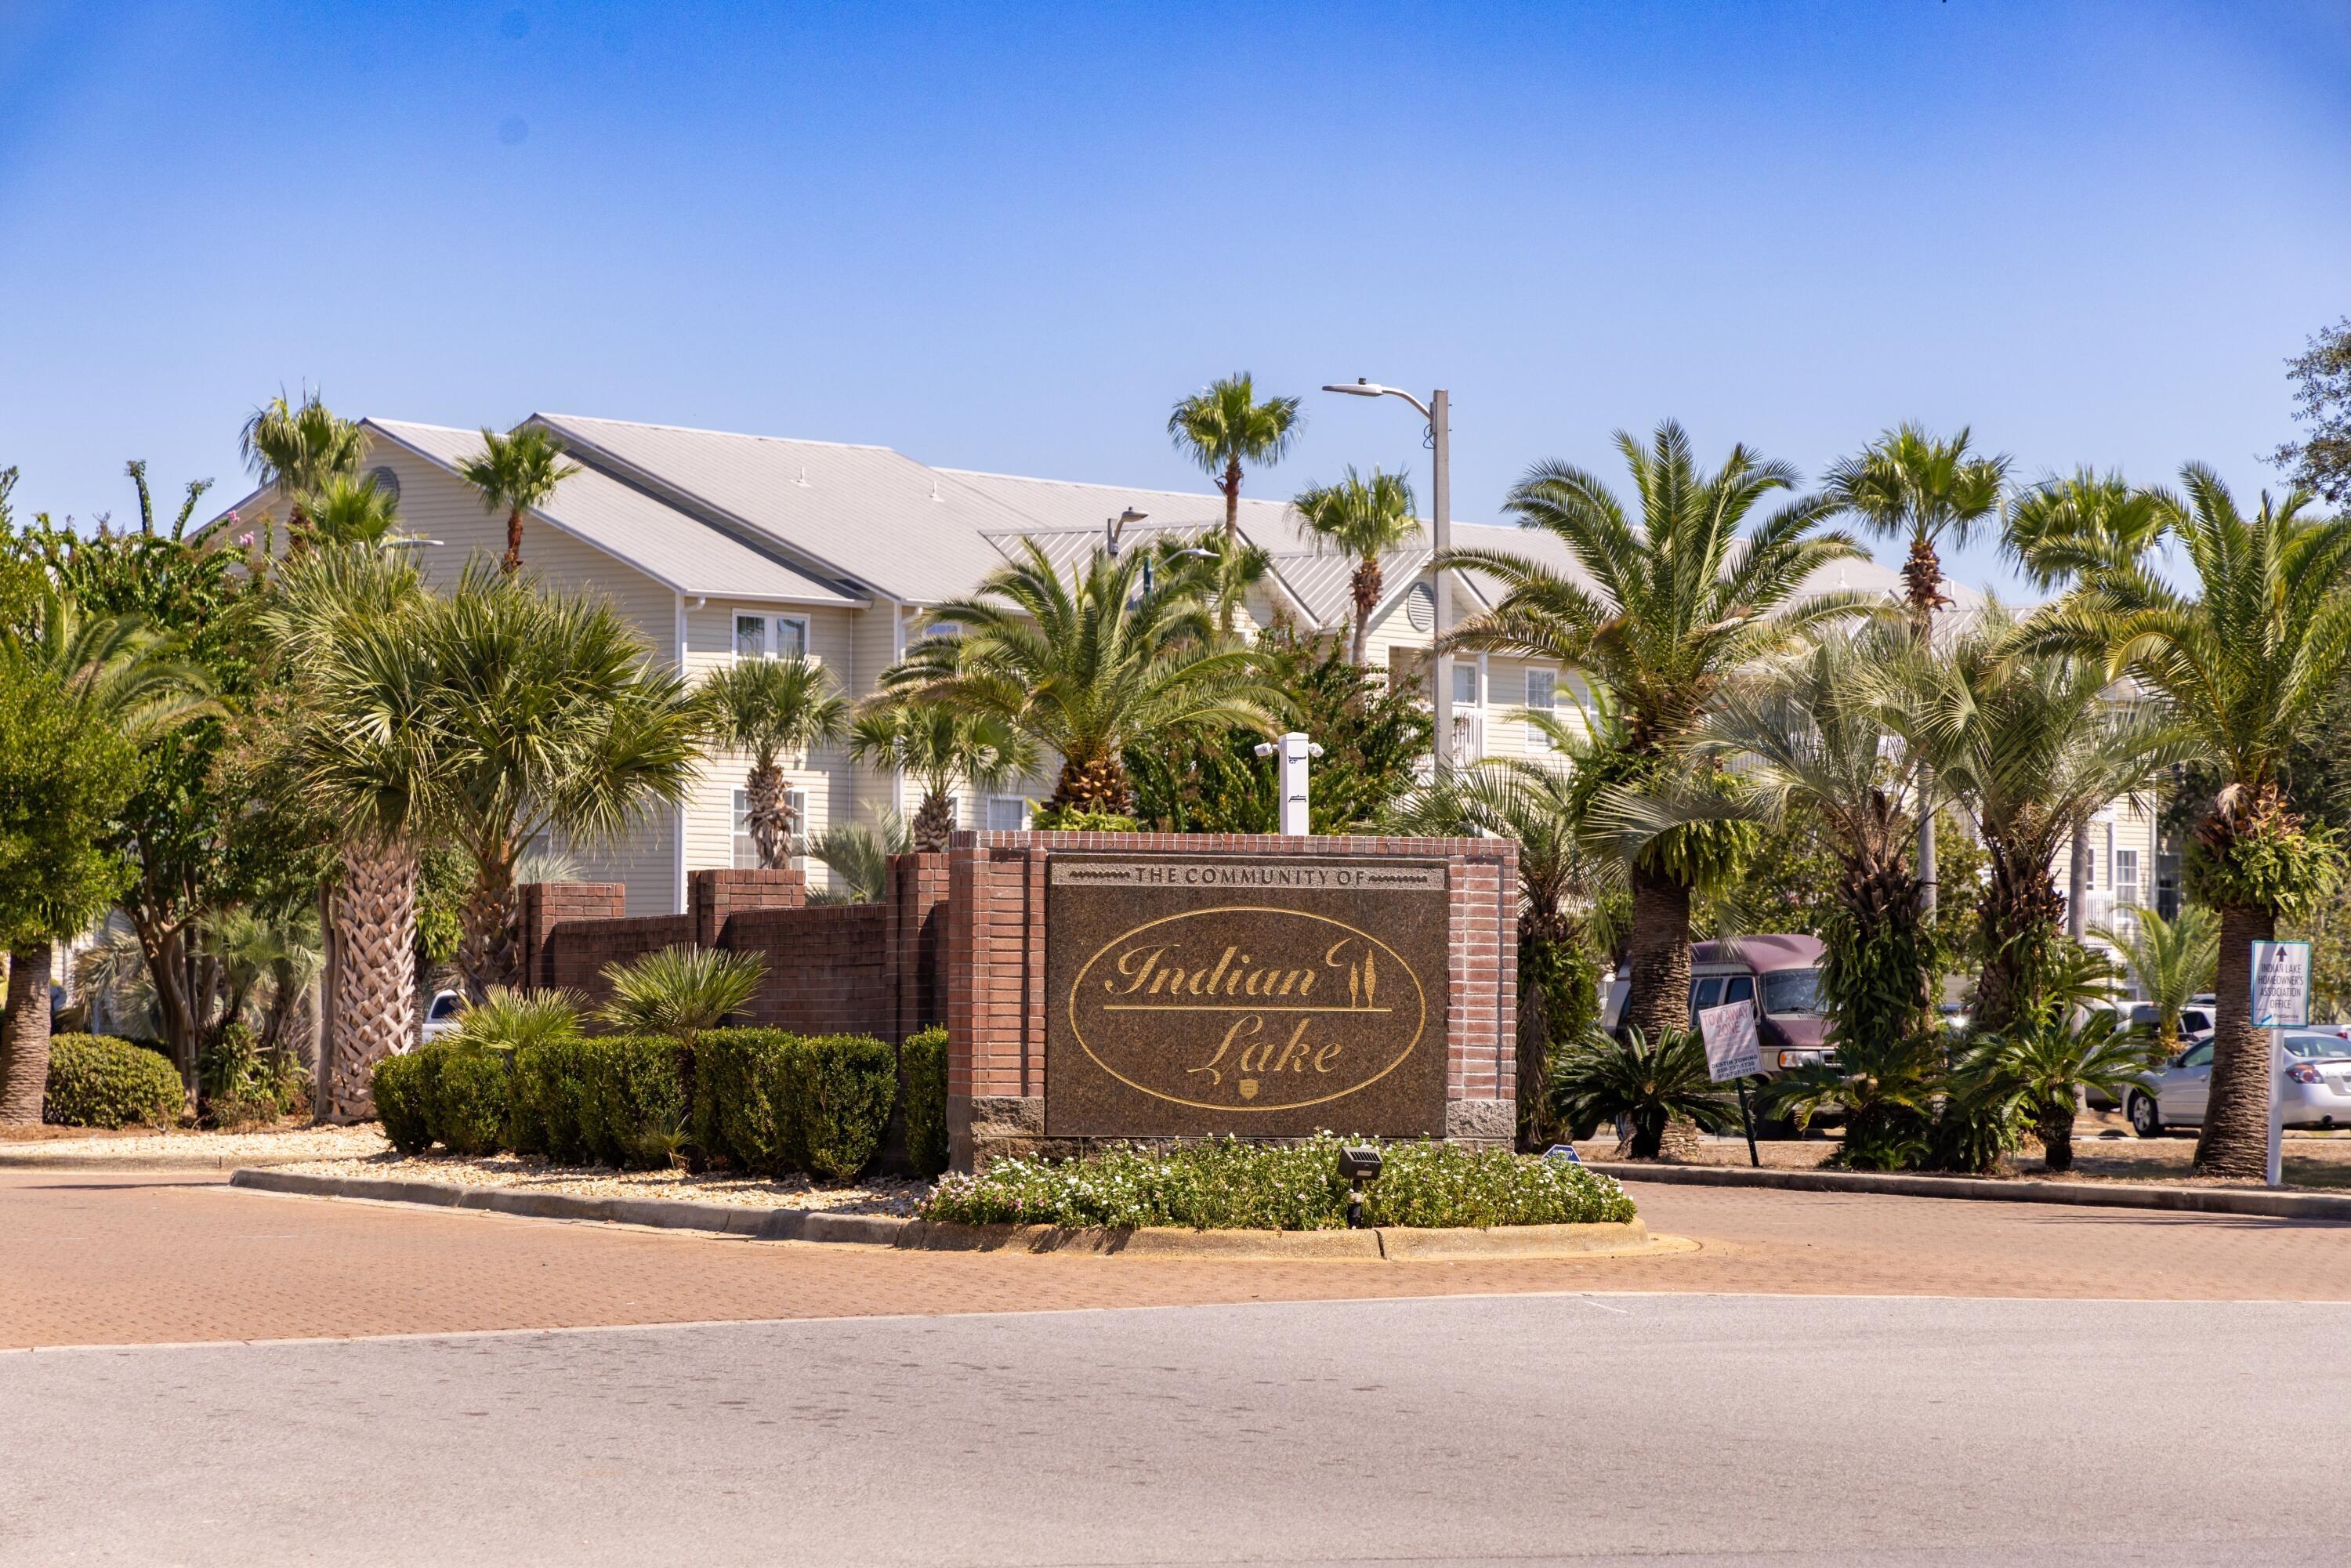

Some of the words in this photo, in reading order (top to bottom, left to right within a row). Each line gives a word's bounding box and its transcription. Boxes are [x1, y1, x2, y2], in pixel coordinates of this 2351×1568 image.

[1136, 867, 1176, 883] THE
[1185, 868, 1329, 885] COMMUNITY
[1337, 870, 1364, 885] OF
[1104, 943, 1323, 995] Indian
[2261, 963, 2284, 972] INDIAN
[2285, 965, 2302, 973] LAKE
[2258, 976, 2304, 985] HOMEOWNER'S
[2260, 987, 2301, 997] ASSOCIATION
[2269, 999, 2291, 1009] OFFICE
[1703, 1012, 1723, 1027] TOW
[1725, 1006, 1748, 1022] AWAY
[1716, 1021, 1741, 1037] ZONE
[1186, 1014, 1345, 1085] Lake
[1712, 1058, 1733, 1069] DESTIN
[1733, 1054, 1758, 1065] TOWING
